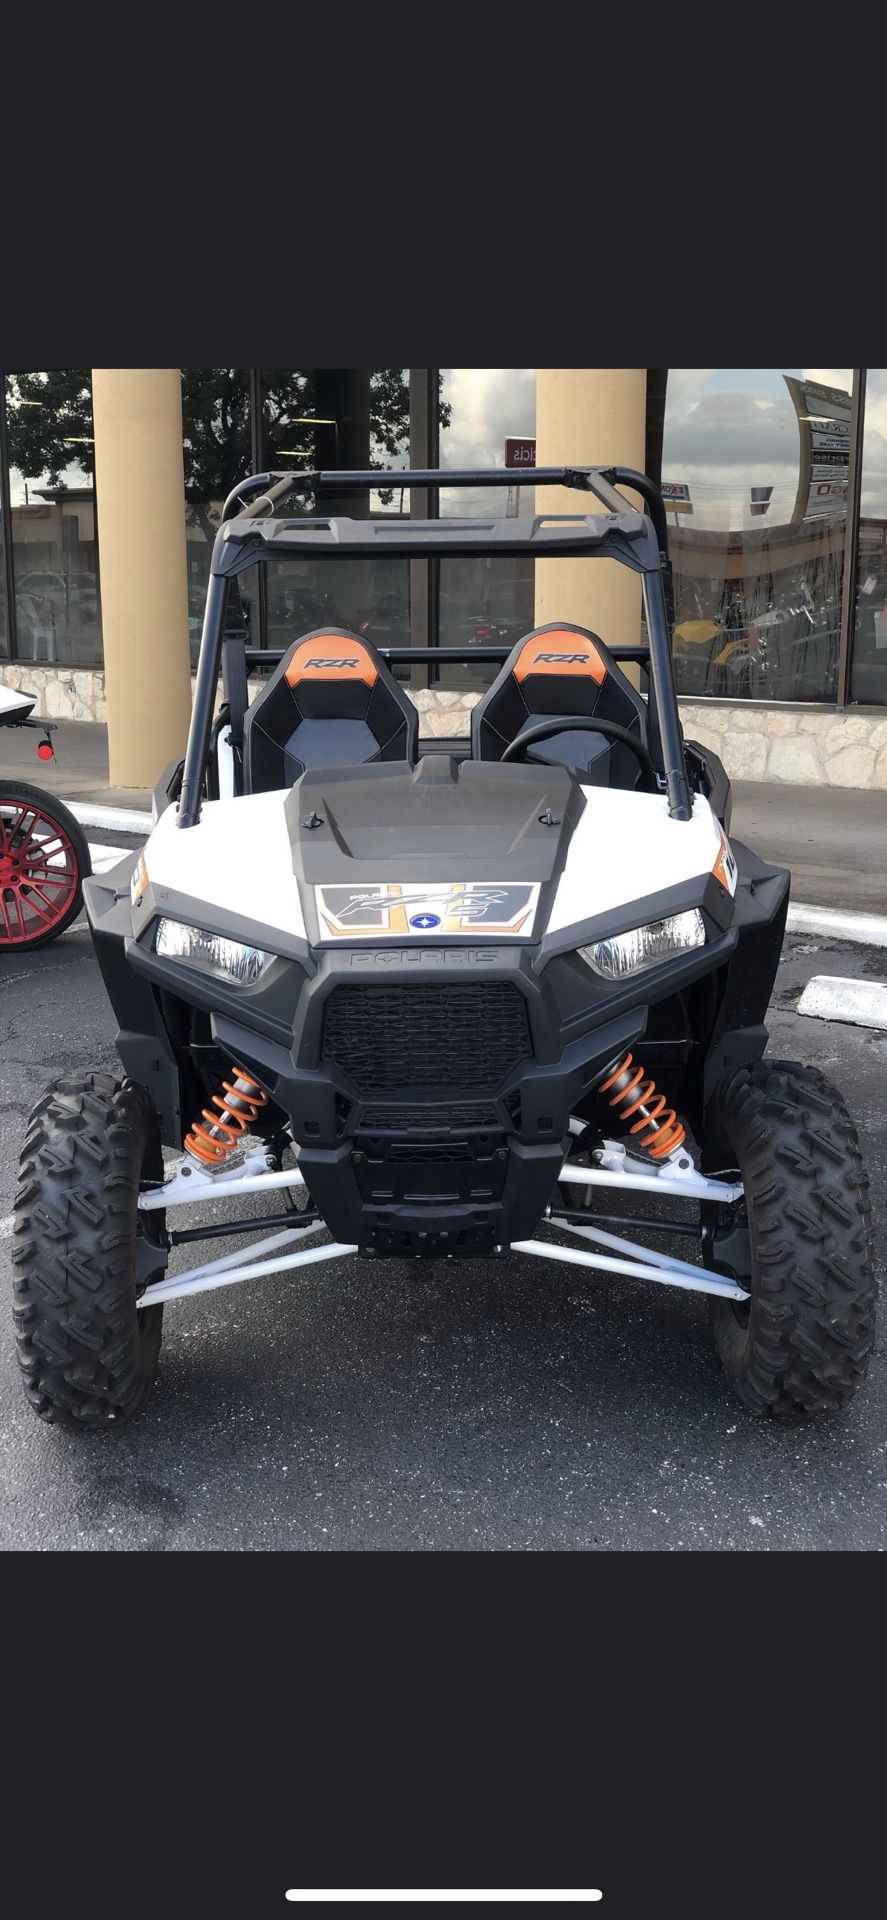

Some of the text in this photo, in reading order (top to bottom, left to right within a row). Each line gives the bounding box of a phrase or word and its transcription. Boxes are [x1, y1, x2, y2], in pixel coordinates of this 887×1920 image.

[303, 658, 360, 668] RZR
[533, 653, 590, 664] RZR
[350, 950, 499, 968] POLARIS
